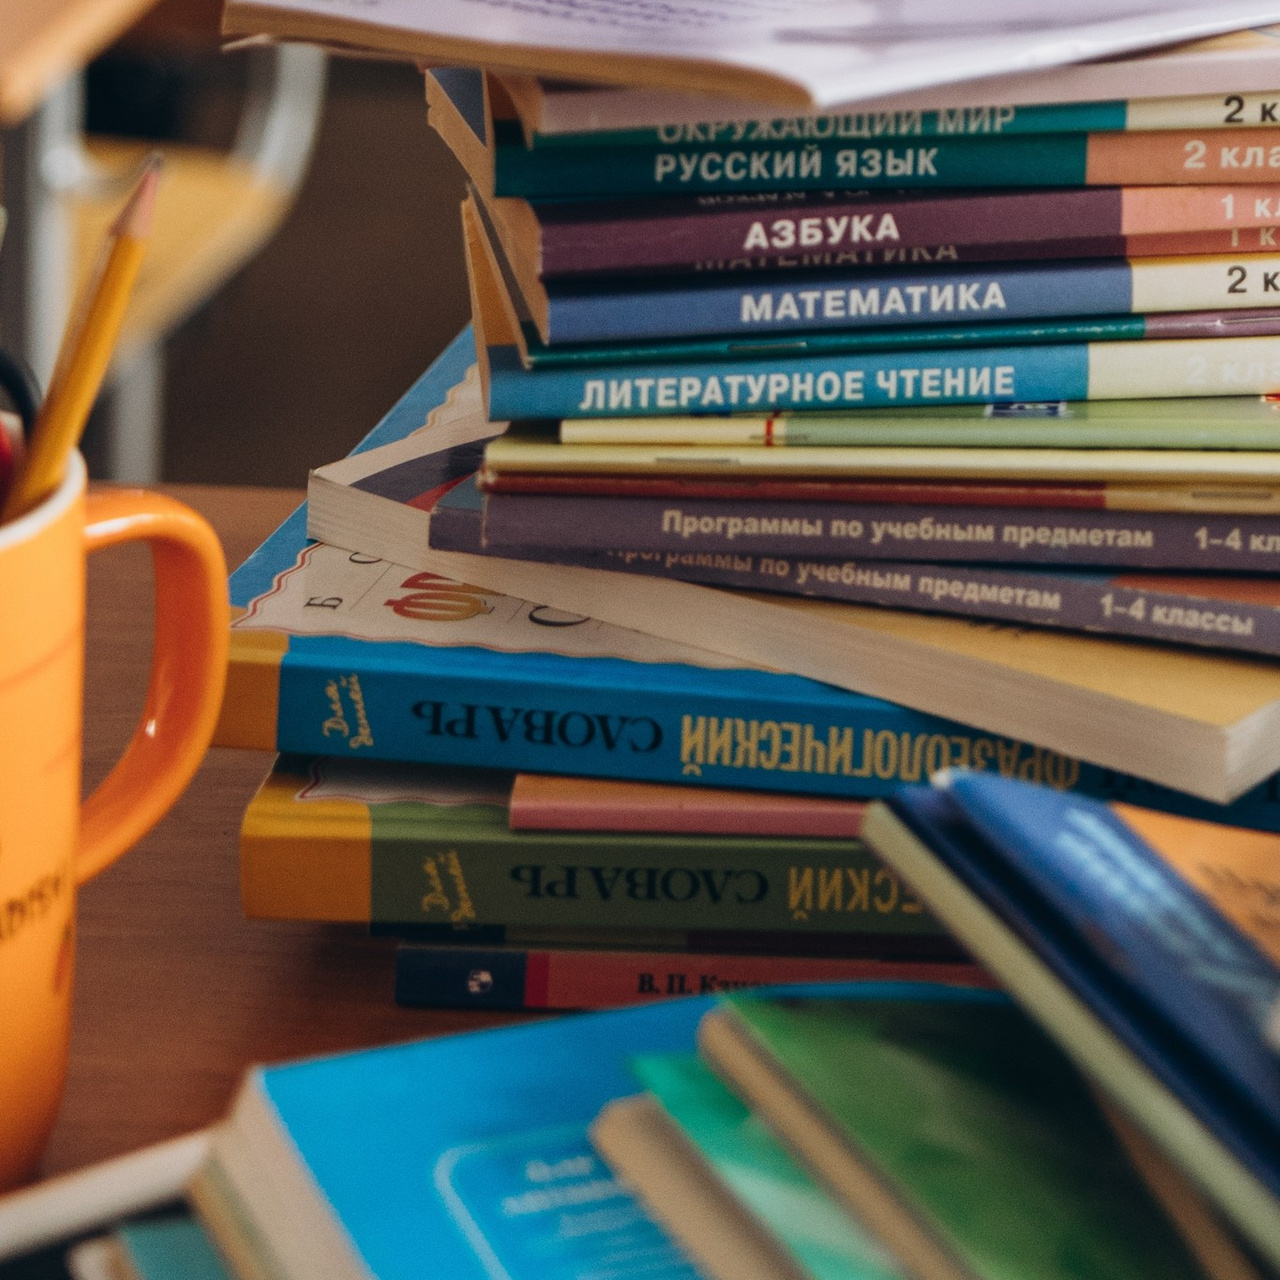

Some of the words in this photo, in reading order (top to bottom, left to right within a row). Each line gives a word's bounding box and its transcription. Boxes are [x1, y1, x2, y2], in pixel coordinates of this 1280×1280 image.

[936, 104, 1016, 136] МИР
[1223, 94, 1245, 124] 2
[653, 143, 823, 183] РУССКИЙ
[835, 146, 939, 179] ЯЗЫК
[1183, 139, 1207, 170] 2
[1221, 193, 1235, 220] 1
[743, 212, 901, 252] АЗБУКА
[1227, 265, 1248, 294] 2
[740, 282, 1007, 323] МАТЕМАТИКА
[578, 370, 866, 411] ЛИТЕРАТУРНОЕ
[875, 366, 1016, 399] ЧТЕНИЕ
[1184, 356, 1207, 385] 2
[661, 507, 824, 540] Программы
[830, 519, 864, 540] по
[871, 513, 995, 546] учебным
[1003, 522, 1155, 550] предметам
[759, 556, 789, 578] по
[796, 556, 912, 593] учебным
[917, 573, 1063, 611] предметам
[1152, 603, 1255, 637] классы
[411, 698, 664, 755] СЛОВАРЬ
[510, 864, 769, 904] СЛОВАРЬ
